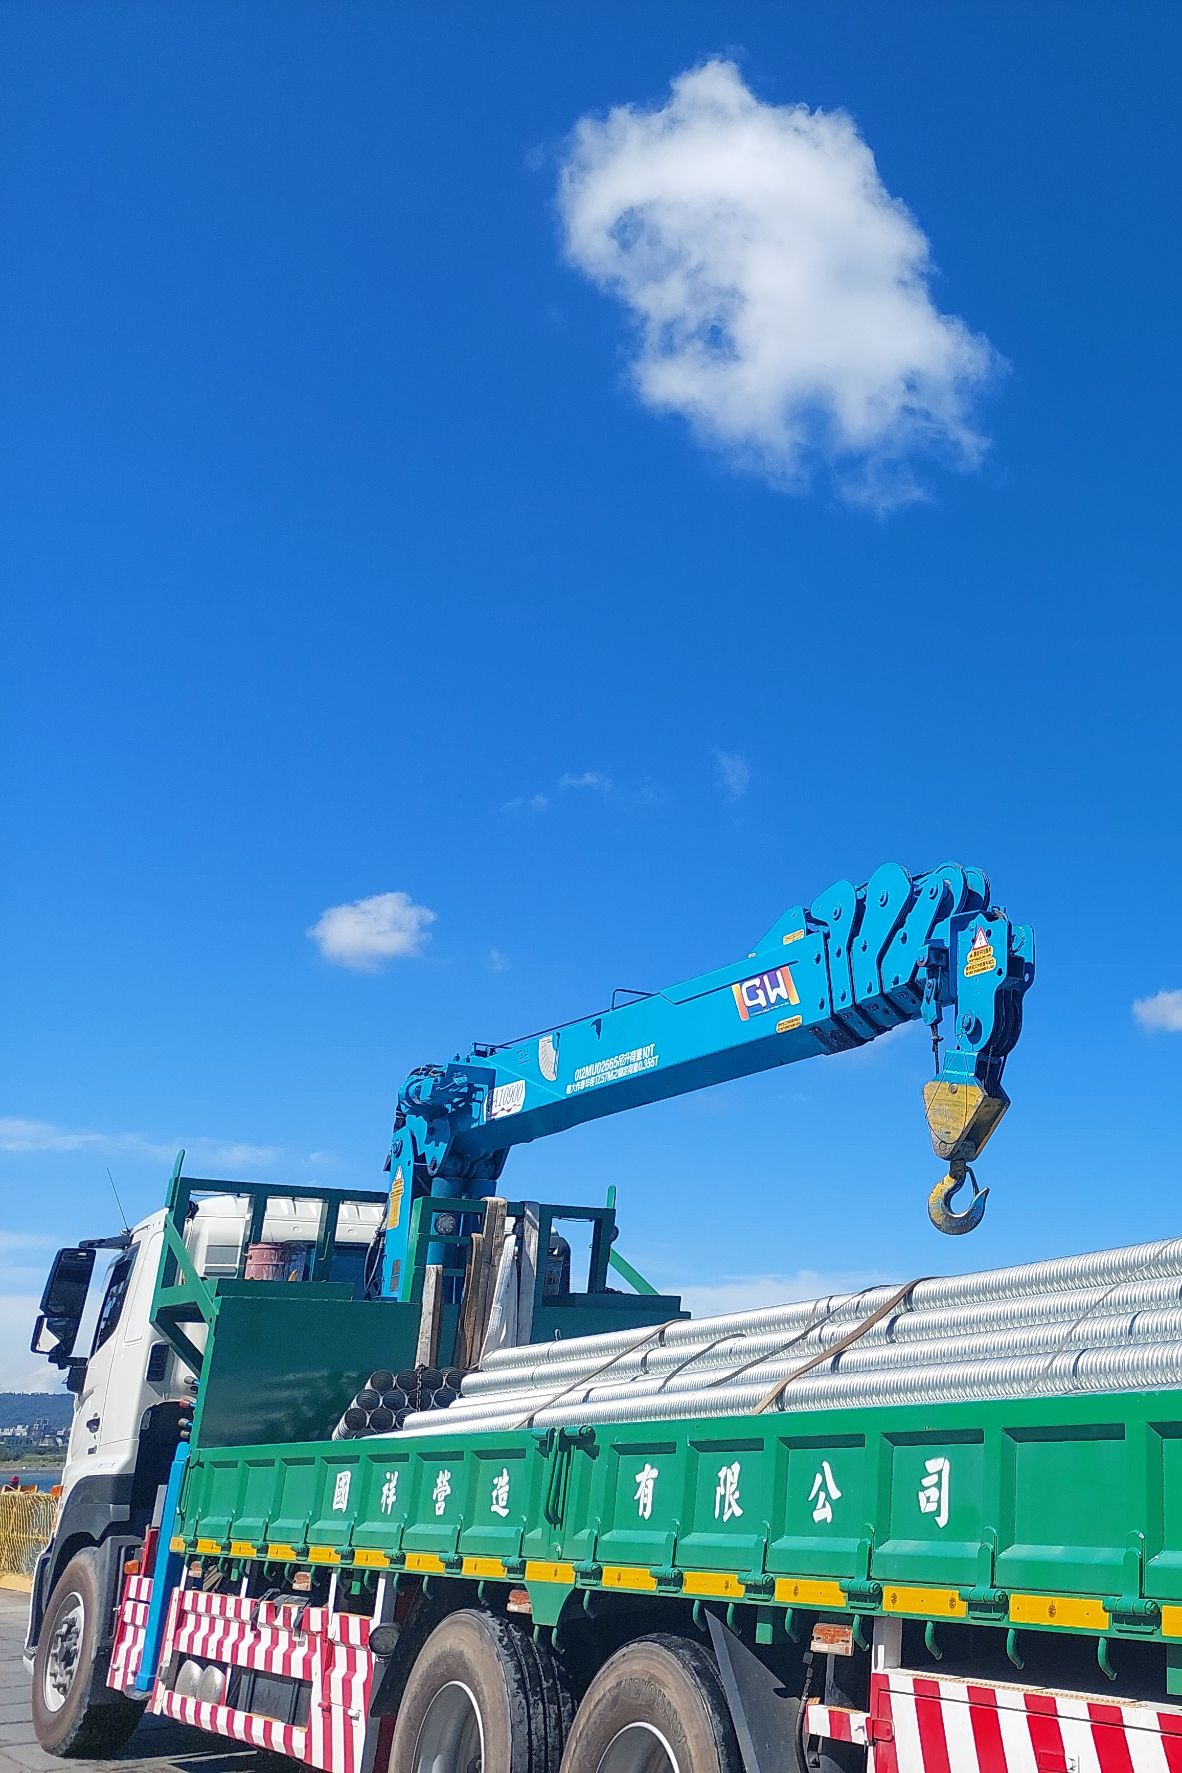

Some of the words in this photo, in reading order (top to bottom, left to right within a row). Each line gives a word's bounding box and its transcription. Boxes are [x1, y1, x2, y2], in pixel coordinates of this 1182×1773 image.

[741, 969, 789, 1008] GW
[332, 1457, 951, 1529] 國祥營造有限公司
